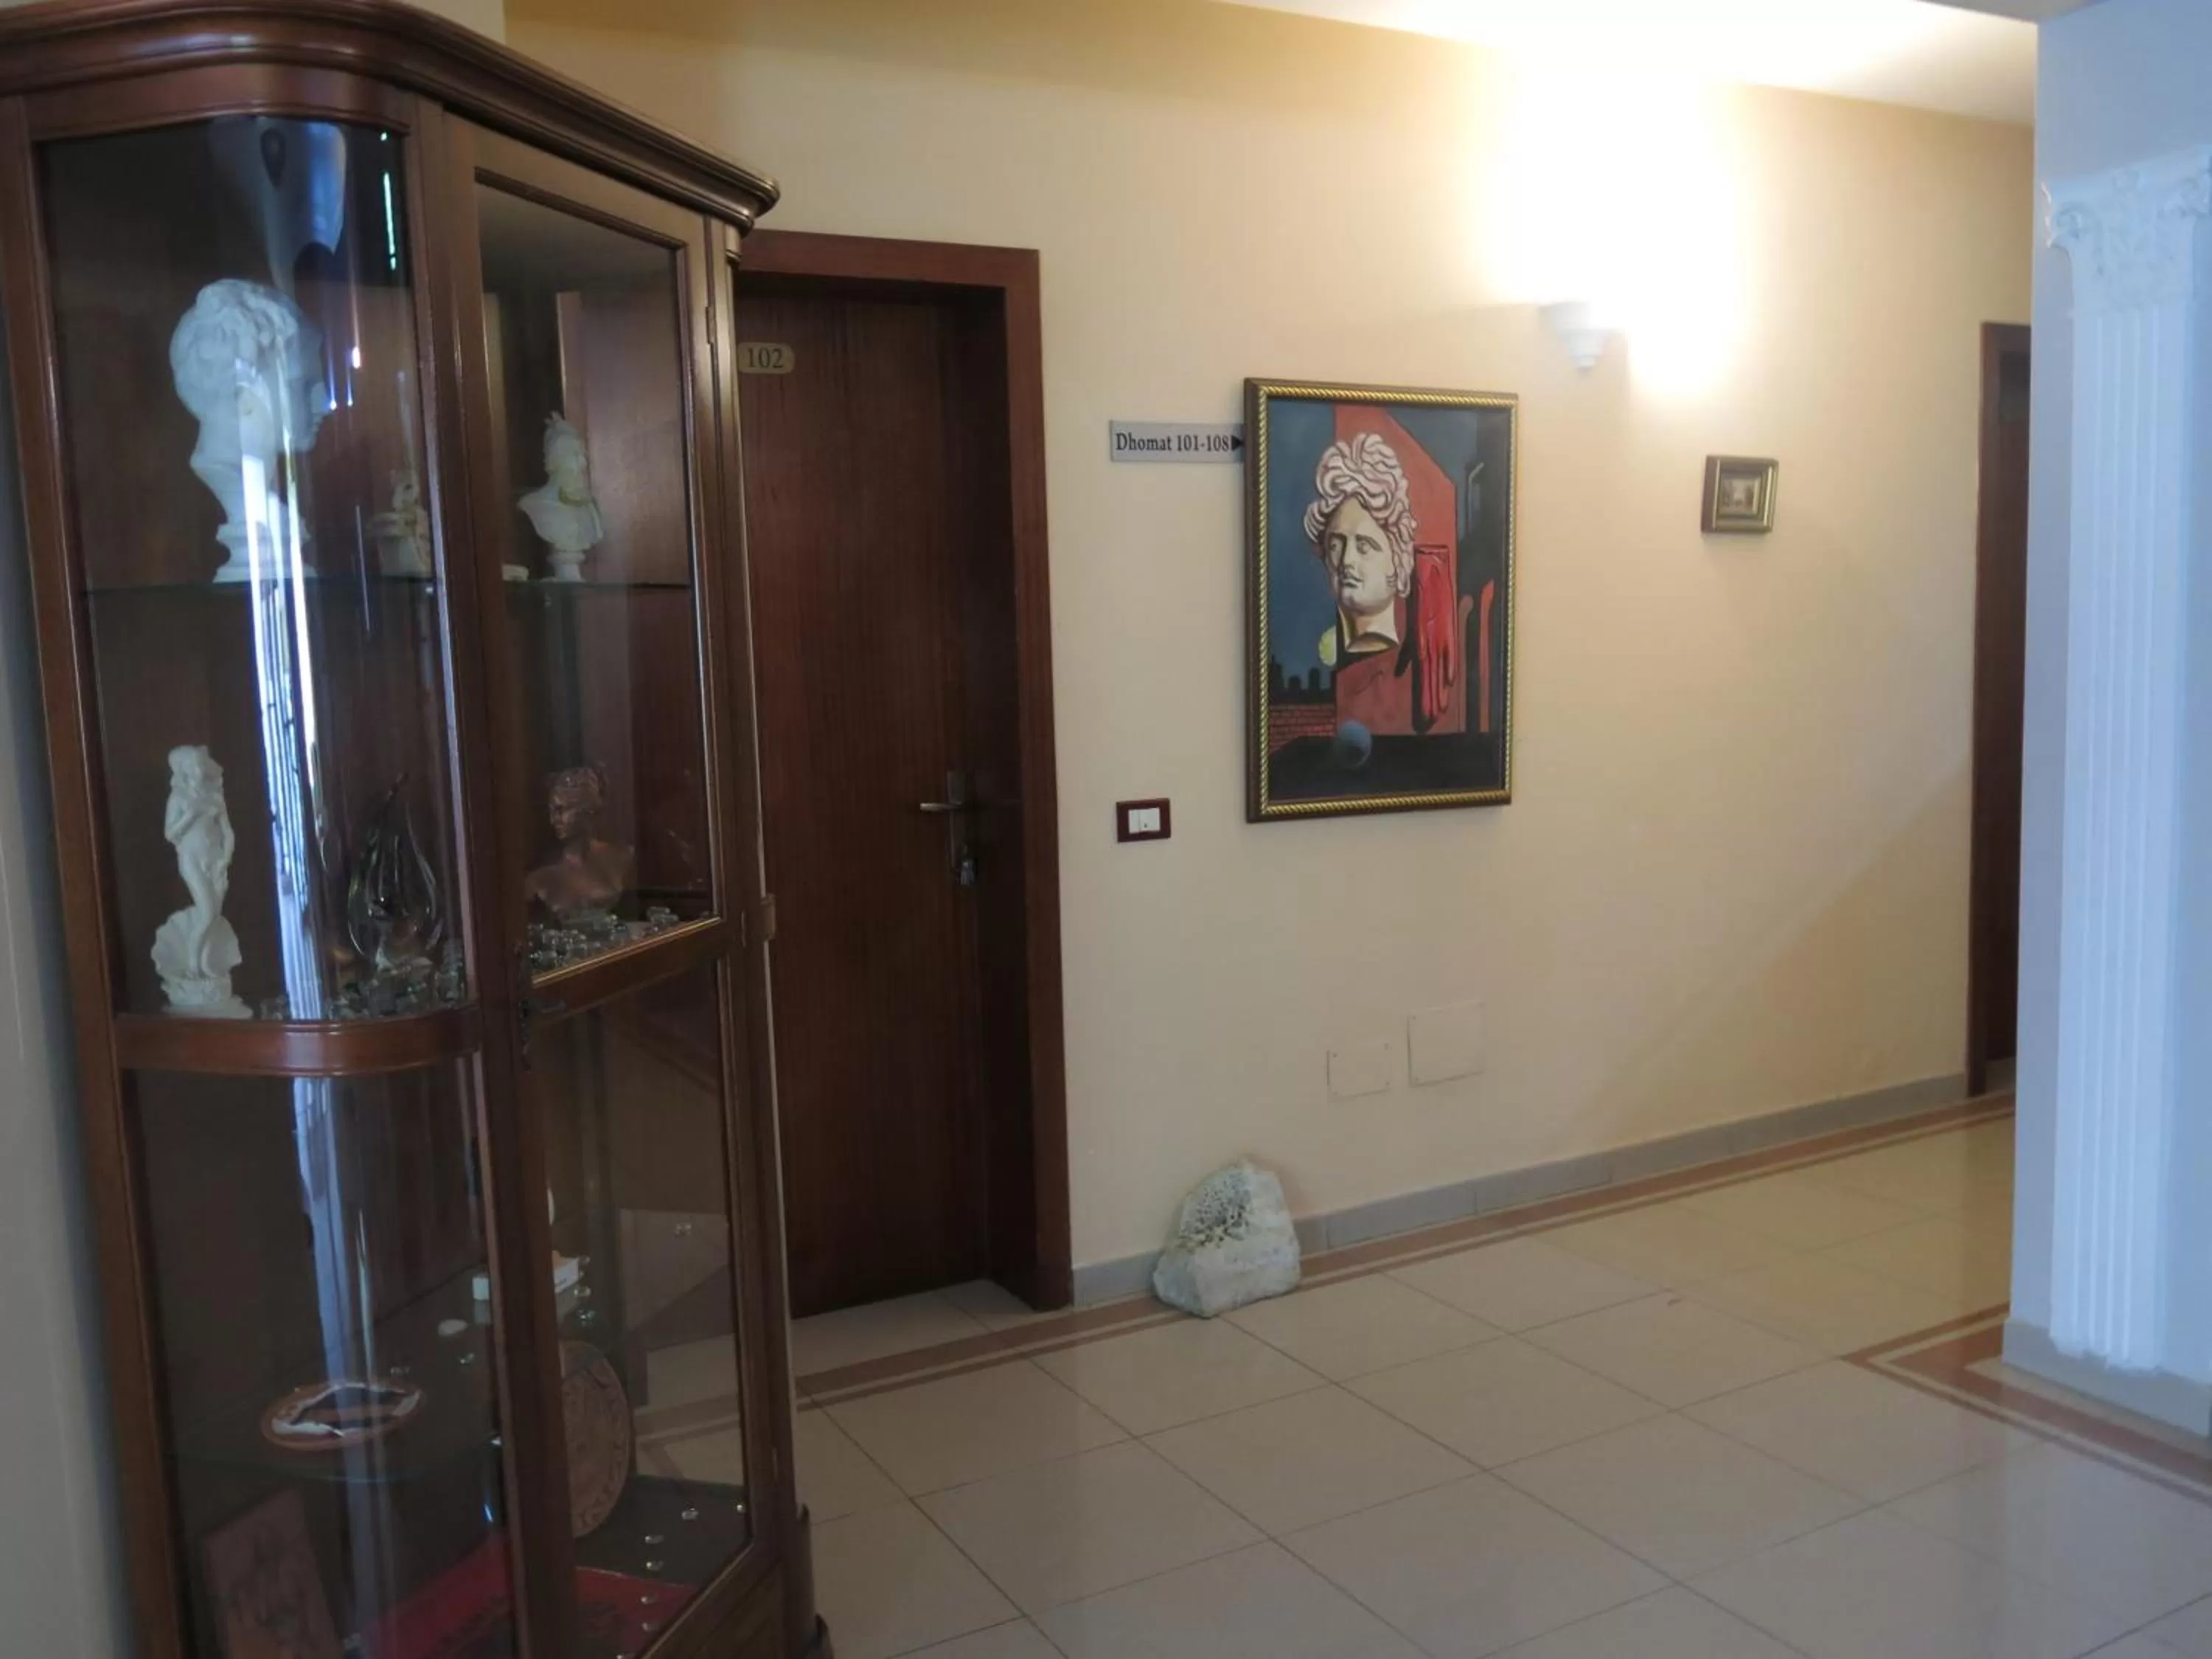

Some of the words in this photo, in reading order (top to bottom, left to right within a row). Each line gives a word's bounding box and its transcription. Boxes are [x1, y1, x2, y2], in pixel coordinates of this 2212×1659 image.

[748, 347, 785, 368] 102
[1116, 431, 1172, 451] Dhomat
[1177, 434, 1229, 452] 101-108
